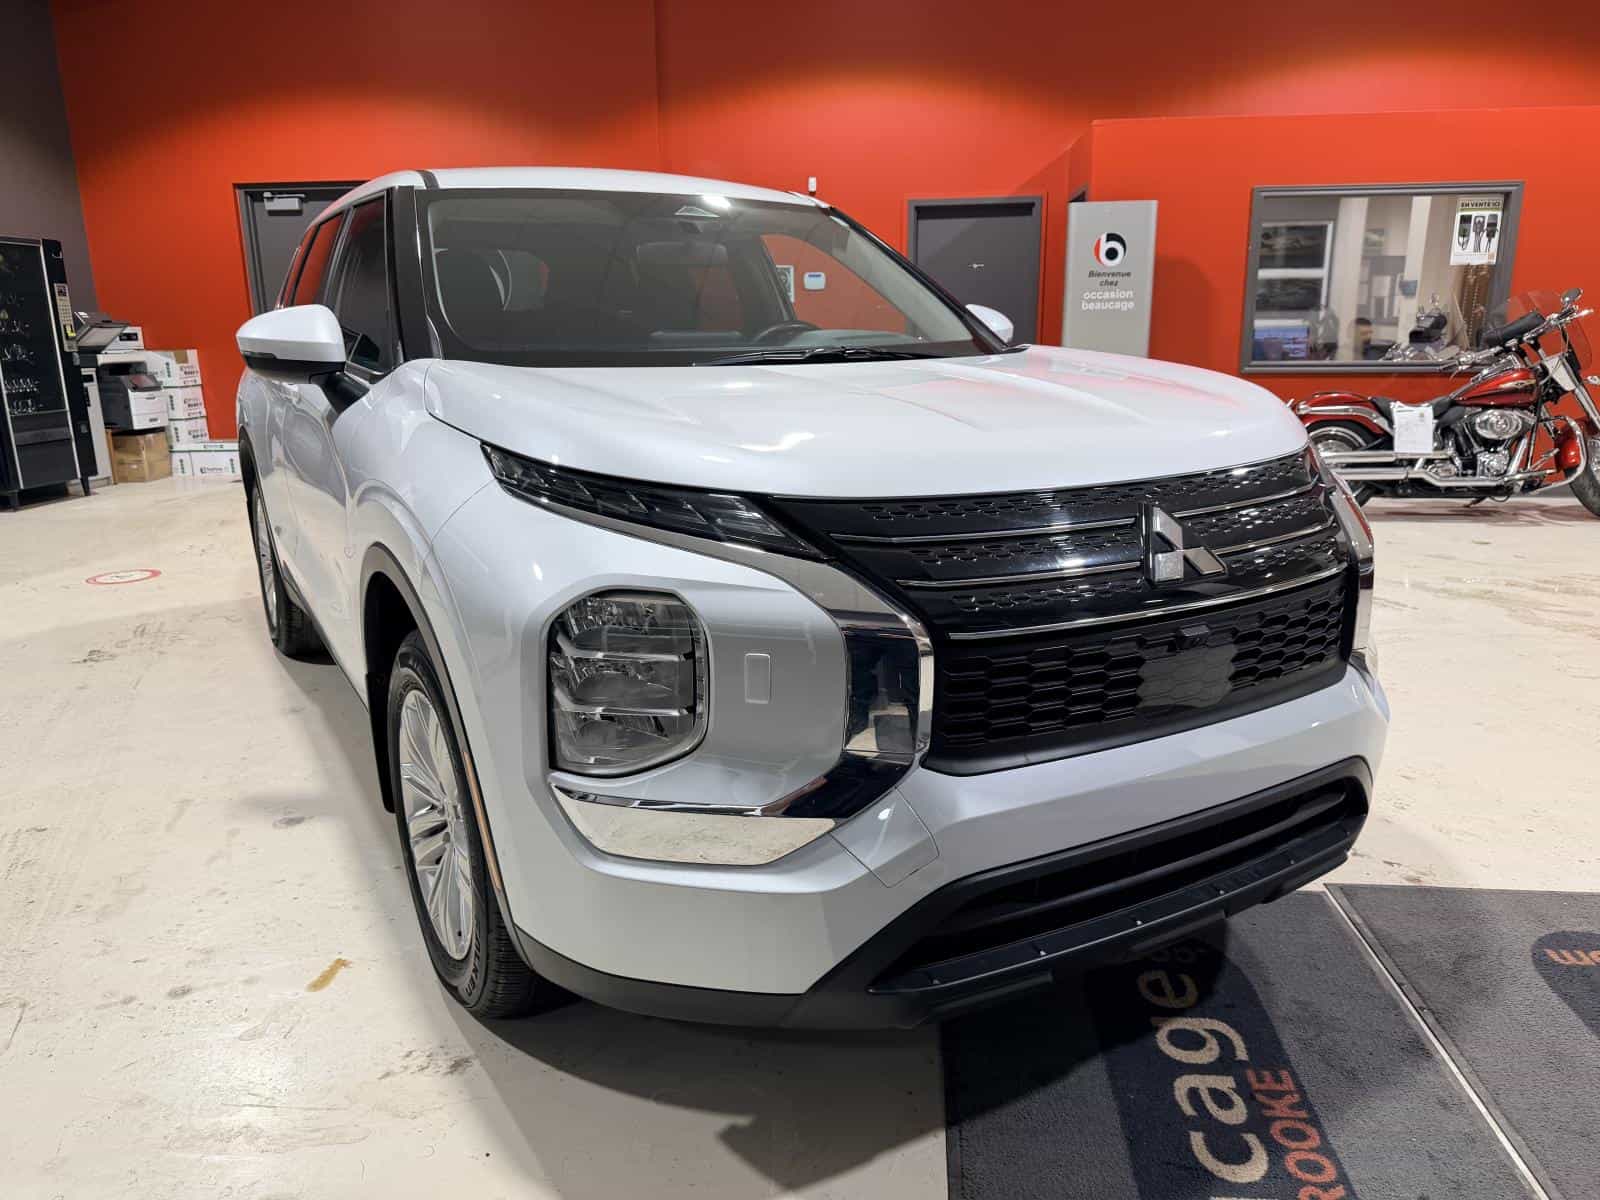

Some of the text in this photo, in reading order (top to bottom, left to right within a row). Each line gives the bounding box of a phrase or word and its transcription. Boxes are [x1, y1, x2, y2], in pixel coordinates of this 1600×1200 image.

[1088, 270, 1132, 278] Bienvenue
[1099, 279, 1119, 287] chez
[1083, 289, 1133, 300] occasion
[1081, 300, 1135, 311] beaucage
